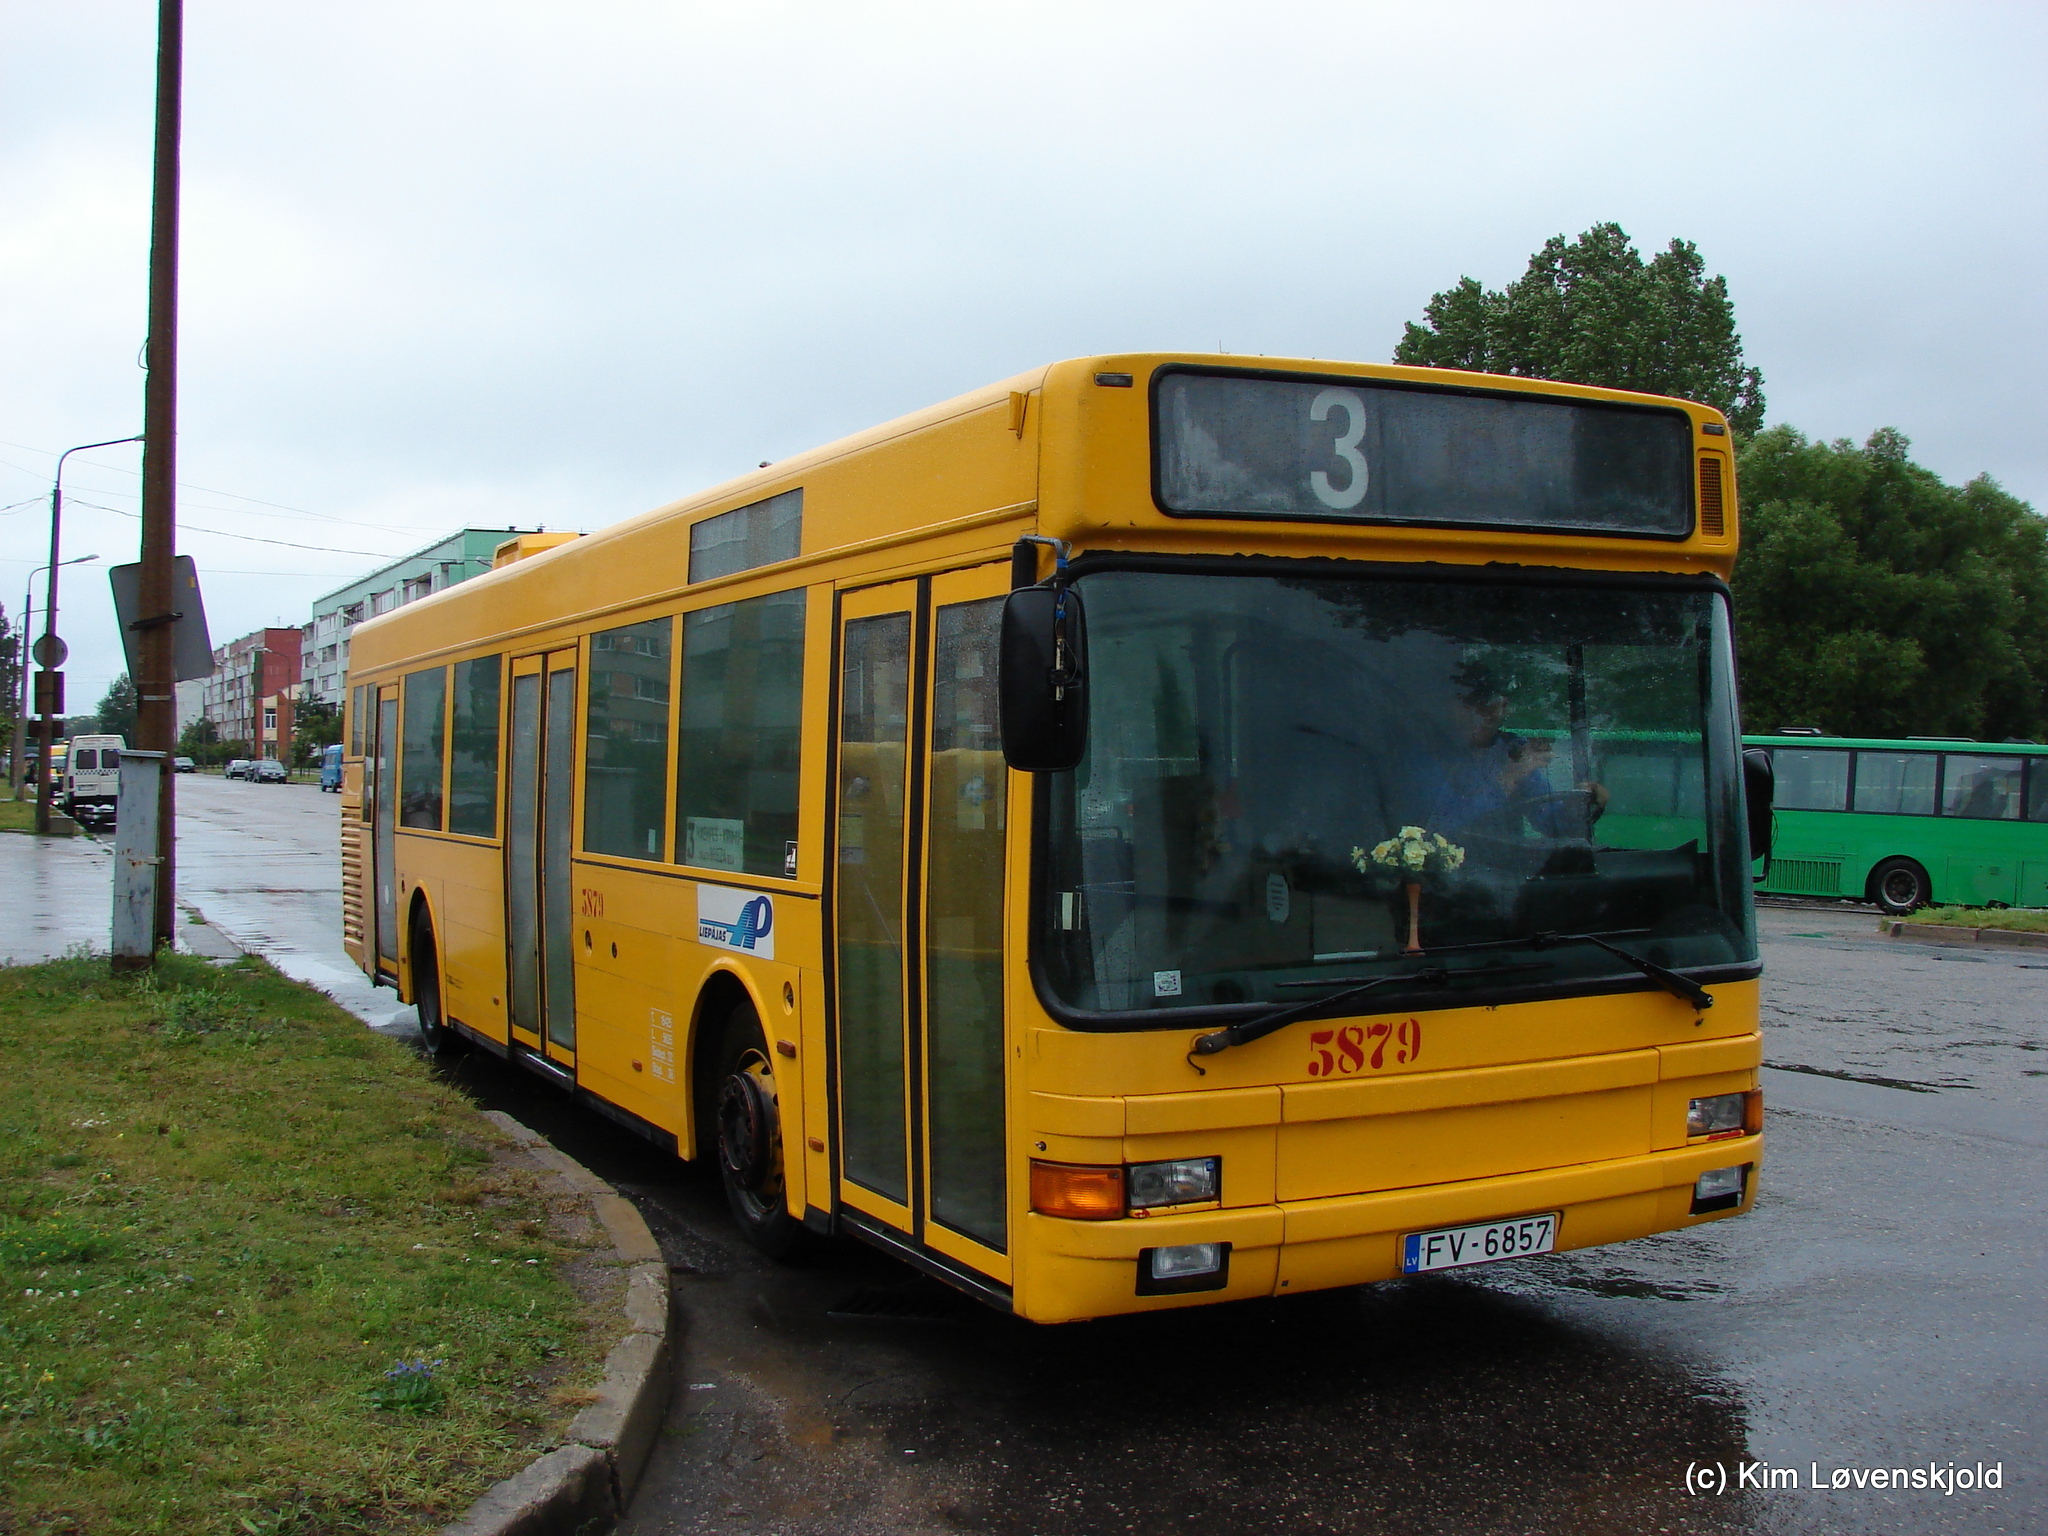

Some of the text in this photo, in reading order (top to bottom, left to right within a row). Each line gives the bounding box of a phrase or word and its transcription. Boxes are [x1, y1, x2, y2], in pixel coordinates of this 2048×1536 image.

[1310, 388, 1369, 509] 3
[581, 888, 604, 918] 5879
[1307, 1018, 1421, 1077] 5879
[1406, 1257, 1418, 1266] LV
[1426, 1219, 1550, 1266] FV-6857
